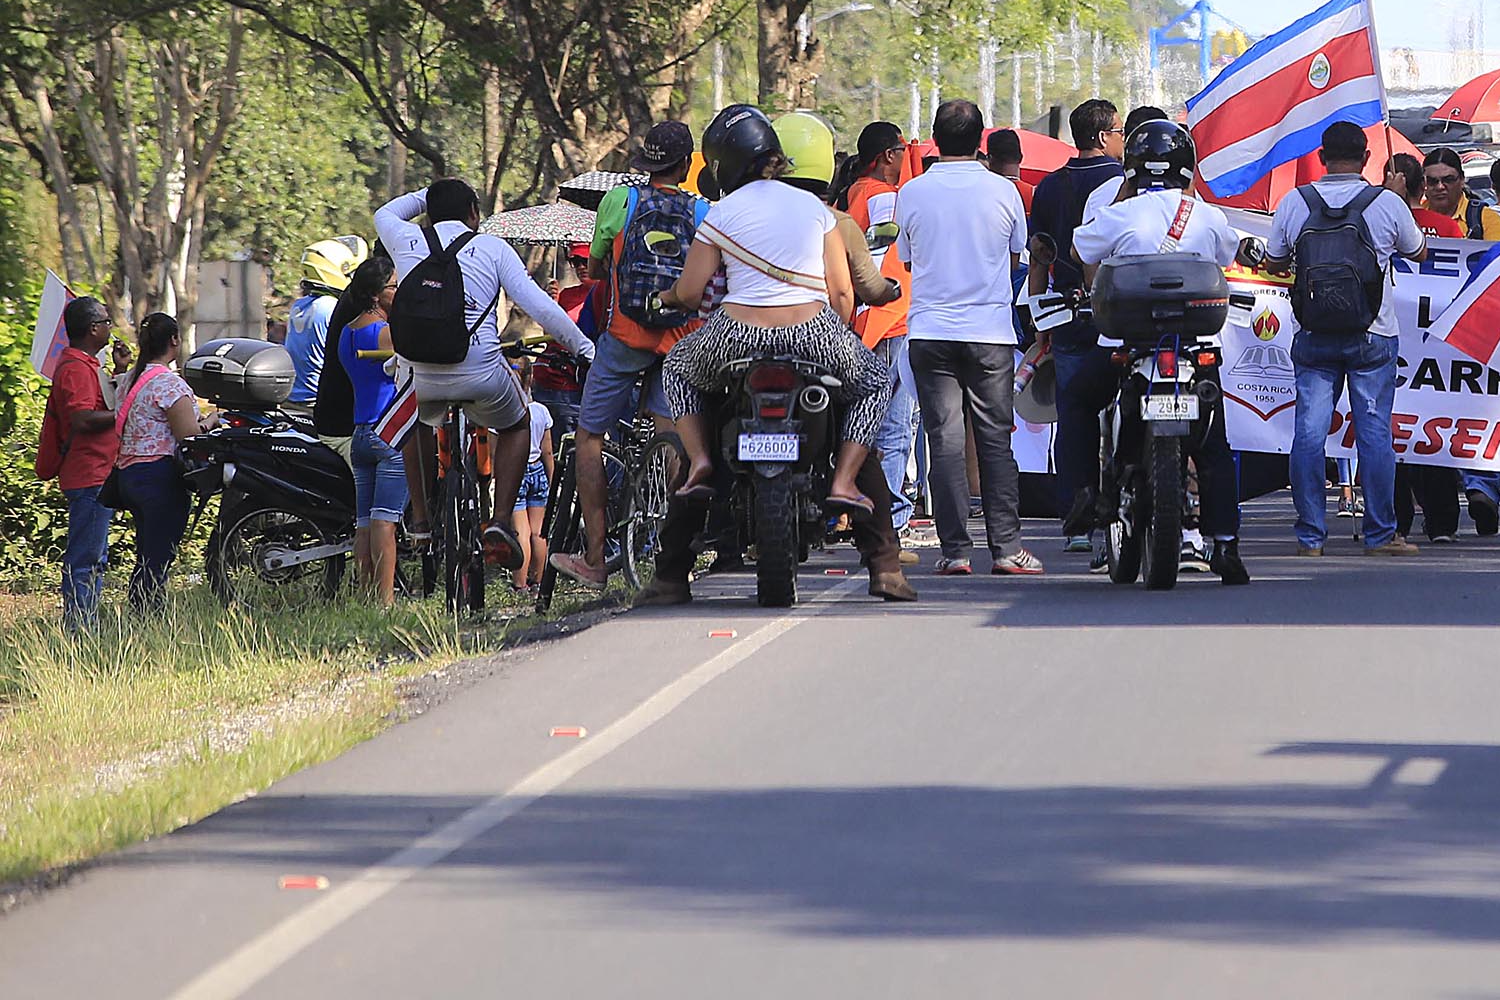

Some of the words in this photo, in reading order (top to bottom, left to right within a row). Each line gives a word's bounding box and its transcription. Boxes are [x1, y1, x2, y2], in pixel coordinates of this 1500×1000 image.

[1236, 382, 1269, 393] COSTA
[1270, 384, 1293, 395] RICA
[1254, 394, 1276, 404] 1955
[270, 444, 308, 454] HONDA
[748, 441, 796, 454] 626002
